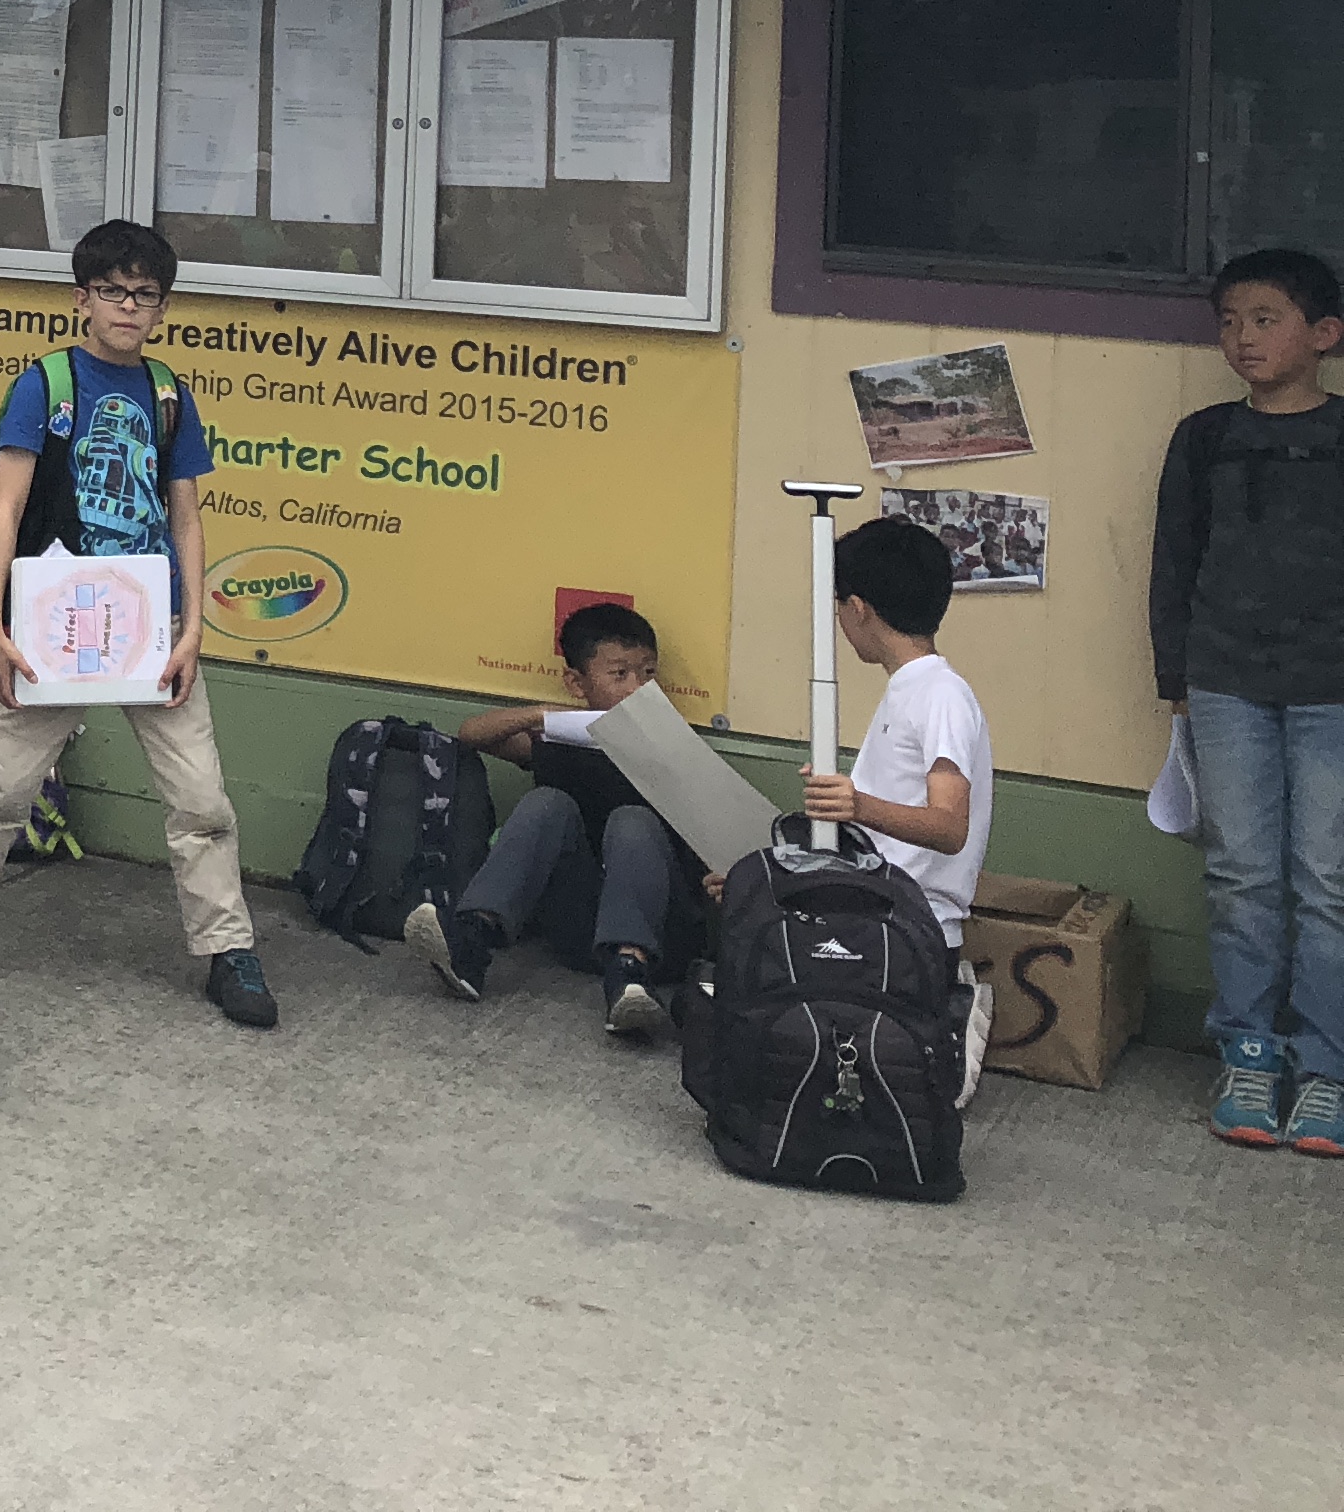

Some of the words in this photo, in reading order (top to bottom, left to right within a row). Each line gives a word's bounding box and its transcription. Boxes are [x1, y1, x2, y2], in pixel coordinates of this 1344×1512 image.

[337, 330, 438, 370] Alive
[243, 373, 326, 406] Grant
[332, 382, 429, 416] Award
[438, 392, 609, 433] 2015-2016
[201, 424, 341, 473] harter
[361, 444, 500, 491] School
[199, 490, 268, 522] Altos,
[279, 498, 402, 534] California
[221, 571, 314, 599] Crayola
[478, 655, 534, 674] National
[537, 662, 559, 677] Art
